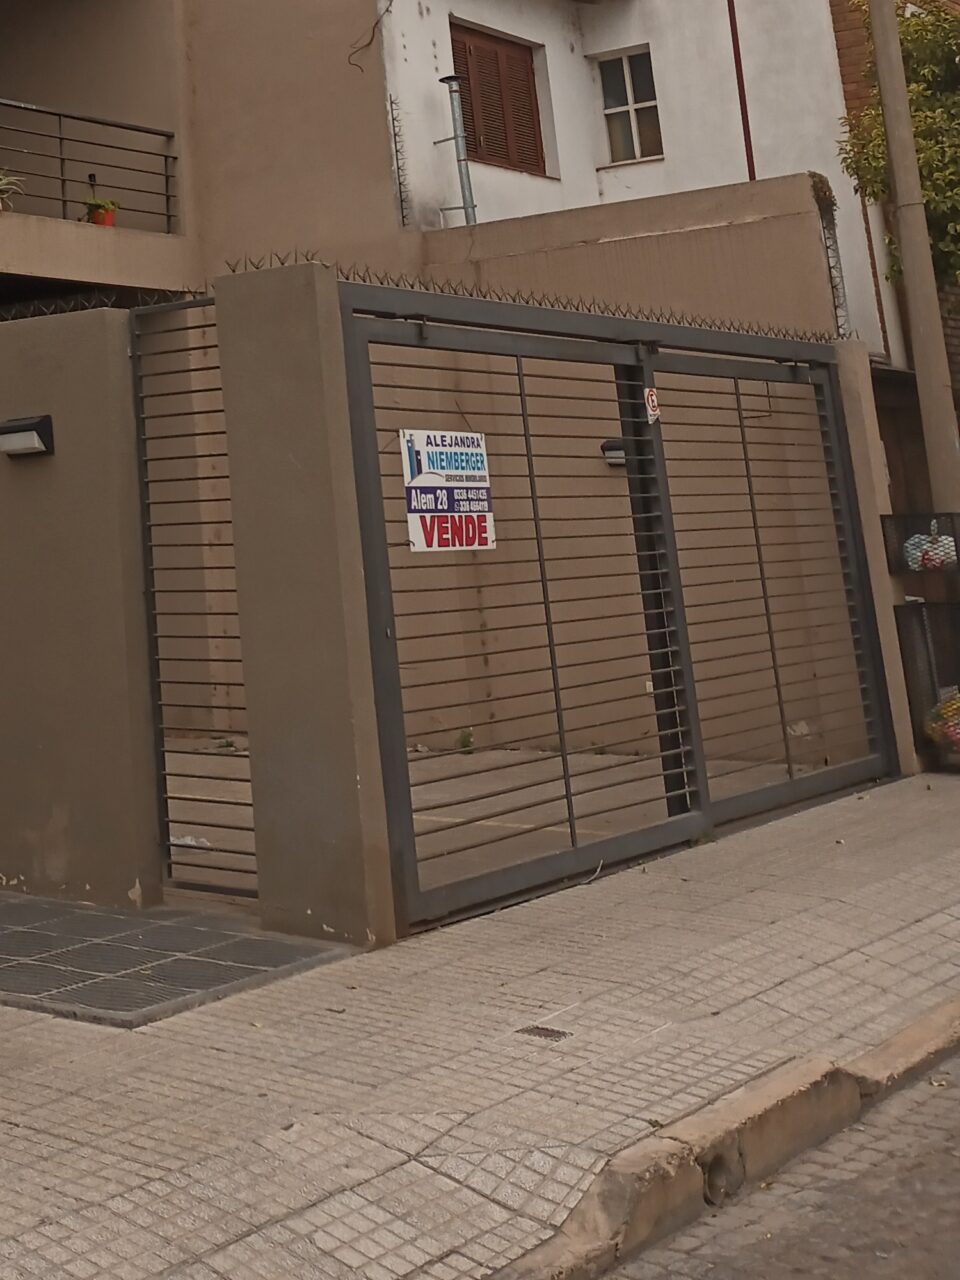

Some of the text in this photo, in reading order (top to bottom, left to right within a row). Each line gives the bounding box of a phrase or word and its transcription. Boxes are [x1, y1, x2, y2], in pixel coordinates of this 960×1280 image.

[426, 435, 481, 448] ALEJANDRA
[427, 451, 486, 471] NIEMBERGER
[411, 489, 448, 510] Alem 28
[419, 515, 488, 548] VENDE
